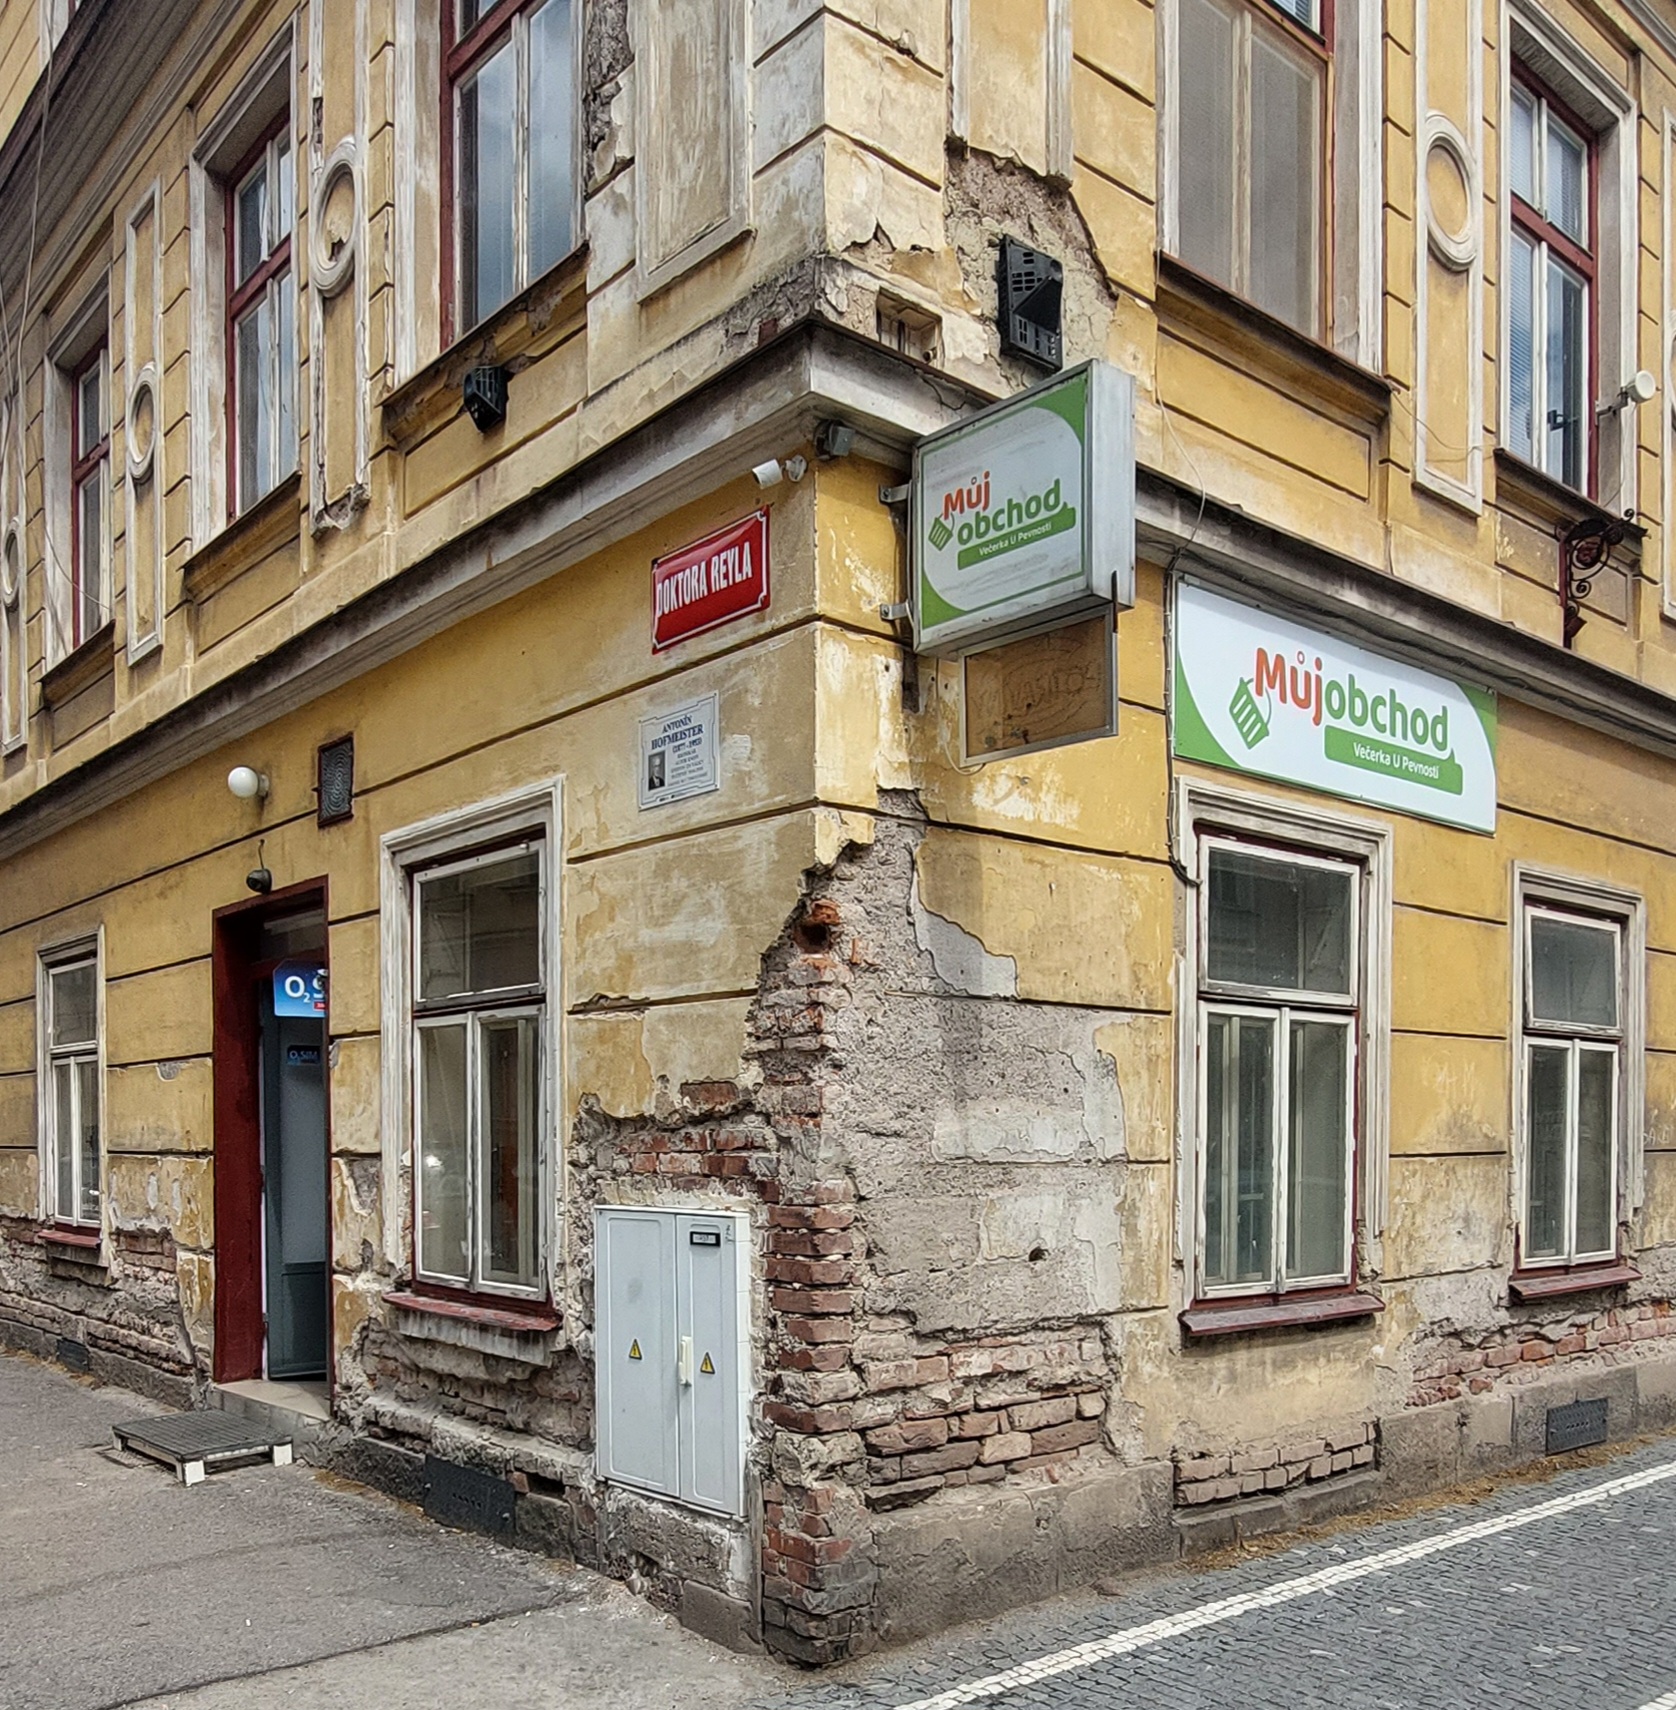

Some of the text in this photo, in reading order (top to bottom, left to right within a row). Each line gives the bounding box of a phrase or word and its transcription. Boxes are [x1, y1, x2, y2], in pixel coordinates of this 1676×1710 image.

[943, 470, 990, 520] Můj
[957, 478, 1060, 546] obchod
[979, 540, 1009, 556] Večerka
[1009, 534, 1017, 545] U
[656, 541, 753, 618] DOKTORA REYLA
[651, 723, 704, 750] HOFMEISTER
[661, 714, 693, 734] ANTONÍN
[1353, 742, 1391, 766] Večerka
[1392, 753, 1400, 768] U
